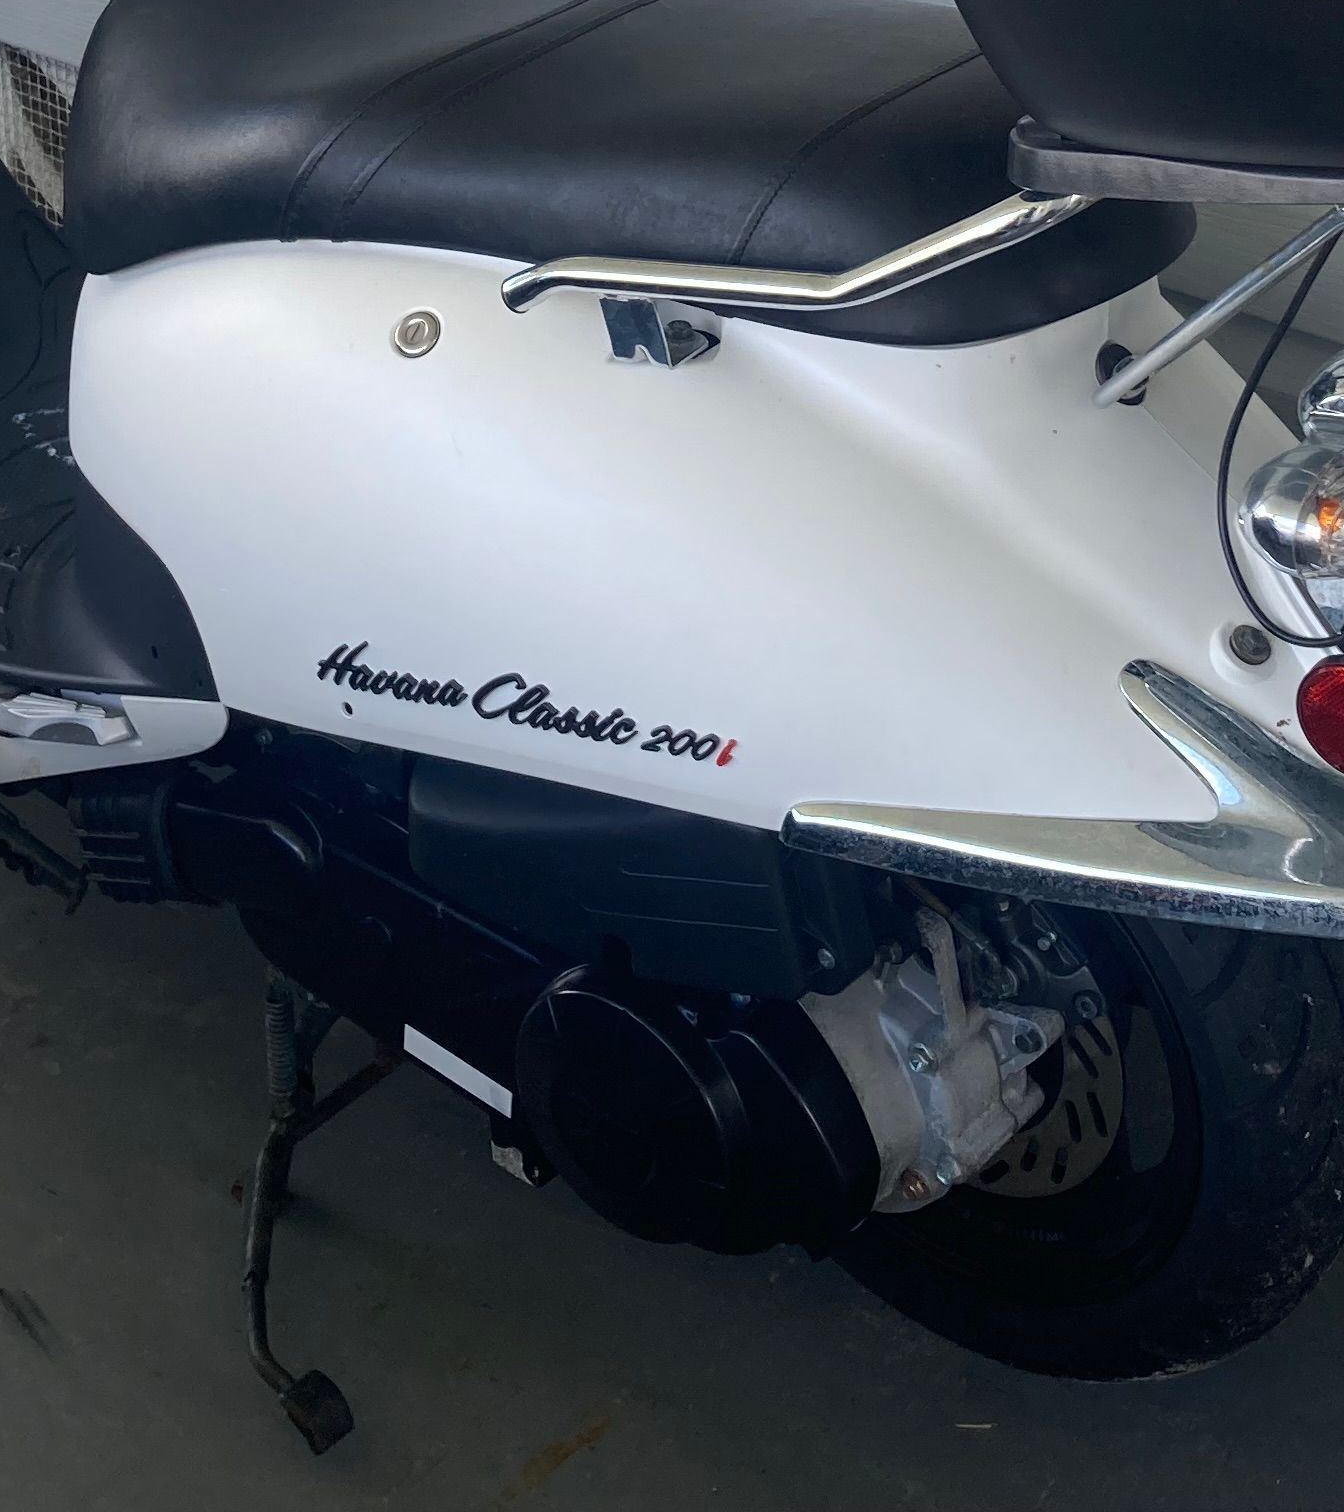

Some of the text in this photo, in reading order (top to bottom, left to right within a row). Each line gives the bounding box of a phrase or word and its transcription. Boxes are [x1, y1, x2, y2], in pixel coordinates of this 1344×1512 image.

[317, 640, 737, 767] Havana Classic 200i
